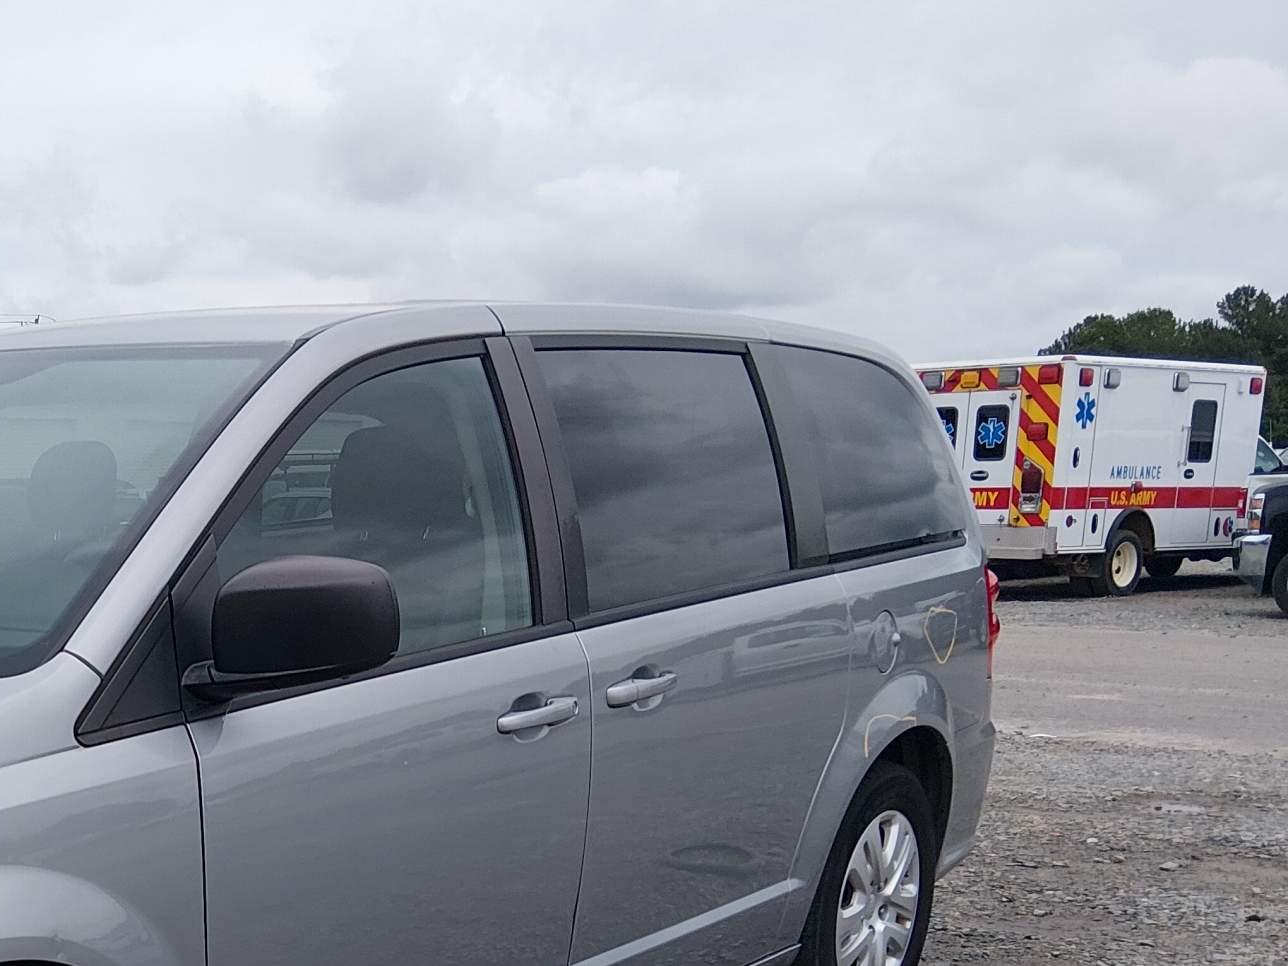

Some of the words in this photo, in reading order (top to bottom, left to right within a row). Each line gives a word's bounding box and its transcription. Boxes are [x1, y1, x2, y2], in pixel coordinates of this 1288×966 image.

[1109, 464, 1162, 480] AMBULANCE
[974, 491, 999, 506] MY
[1110, 490, 1129, 506] U.S.
[1129, 490, 1158, 505] ARMY
